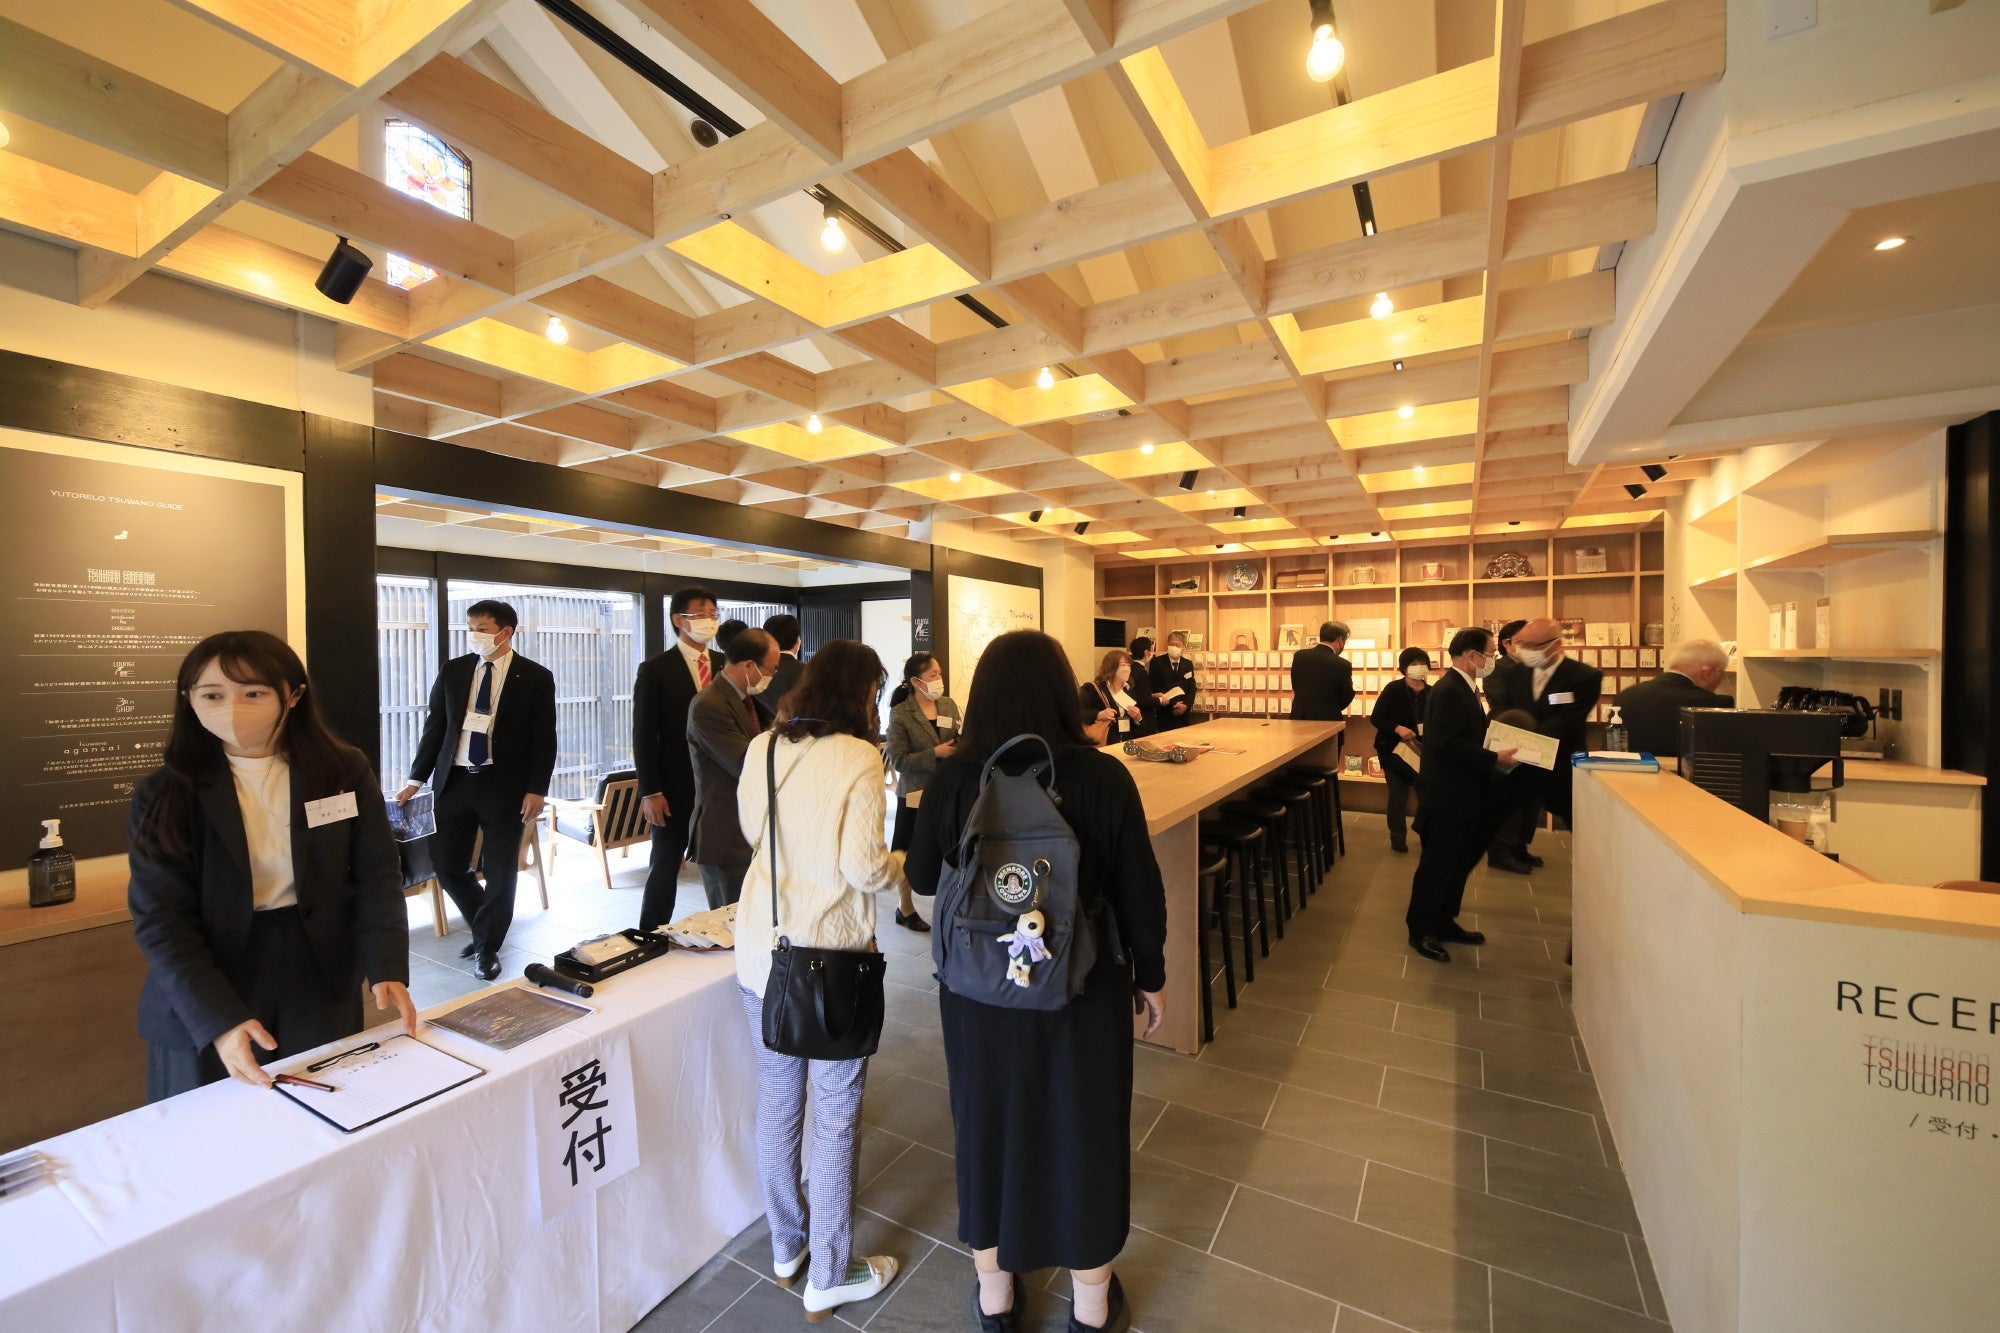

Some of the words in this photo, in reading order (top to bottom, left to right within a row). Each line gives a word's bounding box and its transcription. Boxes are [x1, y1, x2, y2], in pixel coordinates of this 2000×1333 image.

[50, 489, 105, 502] YUTORELO
[108, 496, 154, 507] TSUWANO
[156, 502, 185, 511] GUIDE
[116, 705, 135, 713] SHOP
[63, 745, 120, 755] agansai
[998, 865, 1029, 880] MENSORE
[999, 887, 1029, 901] OKINAWA
[558, 1057, 613, 1187] 受付
